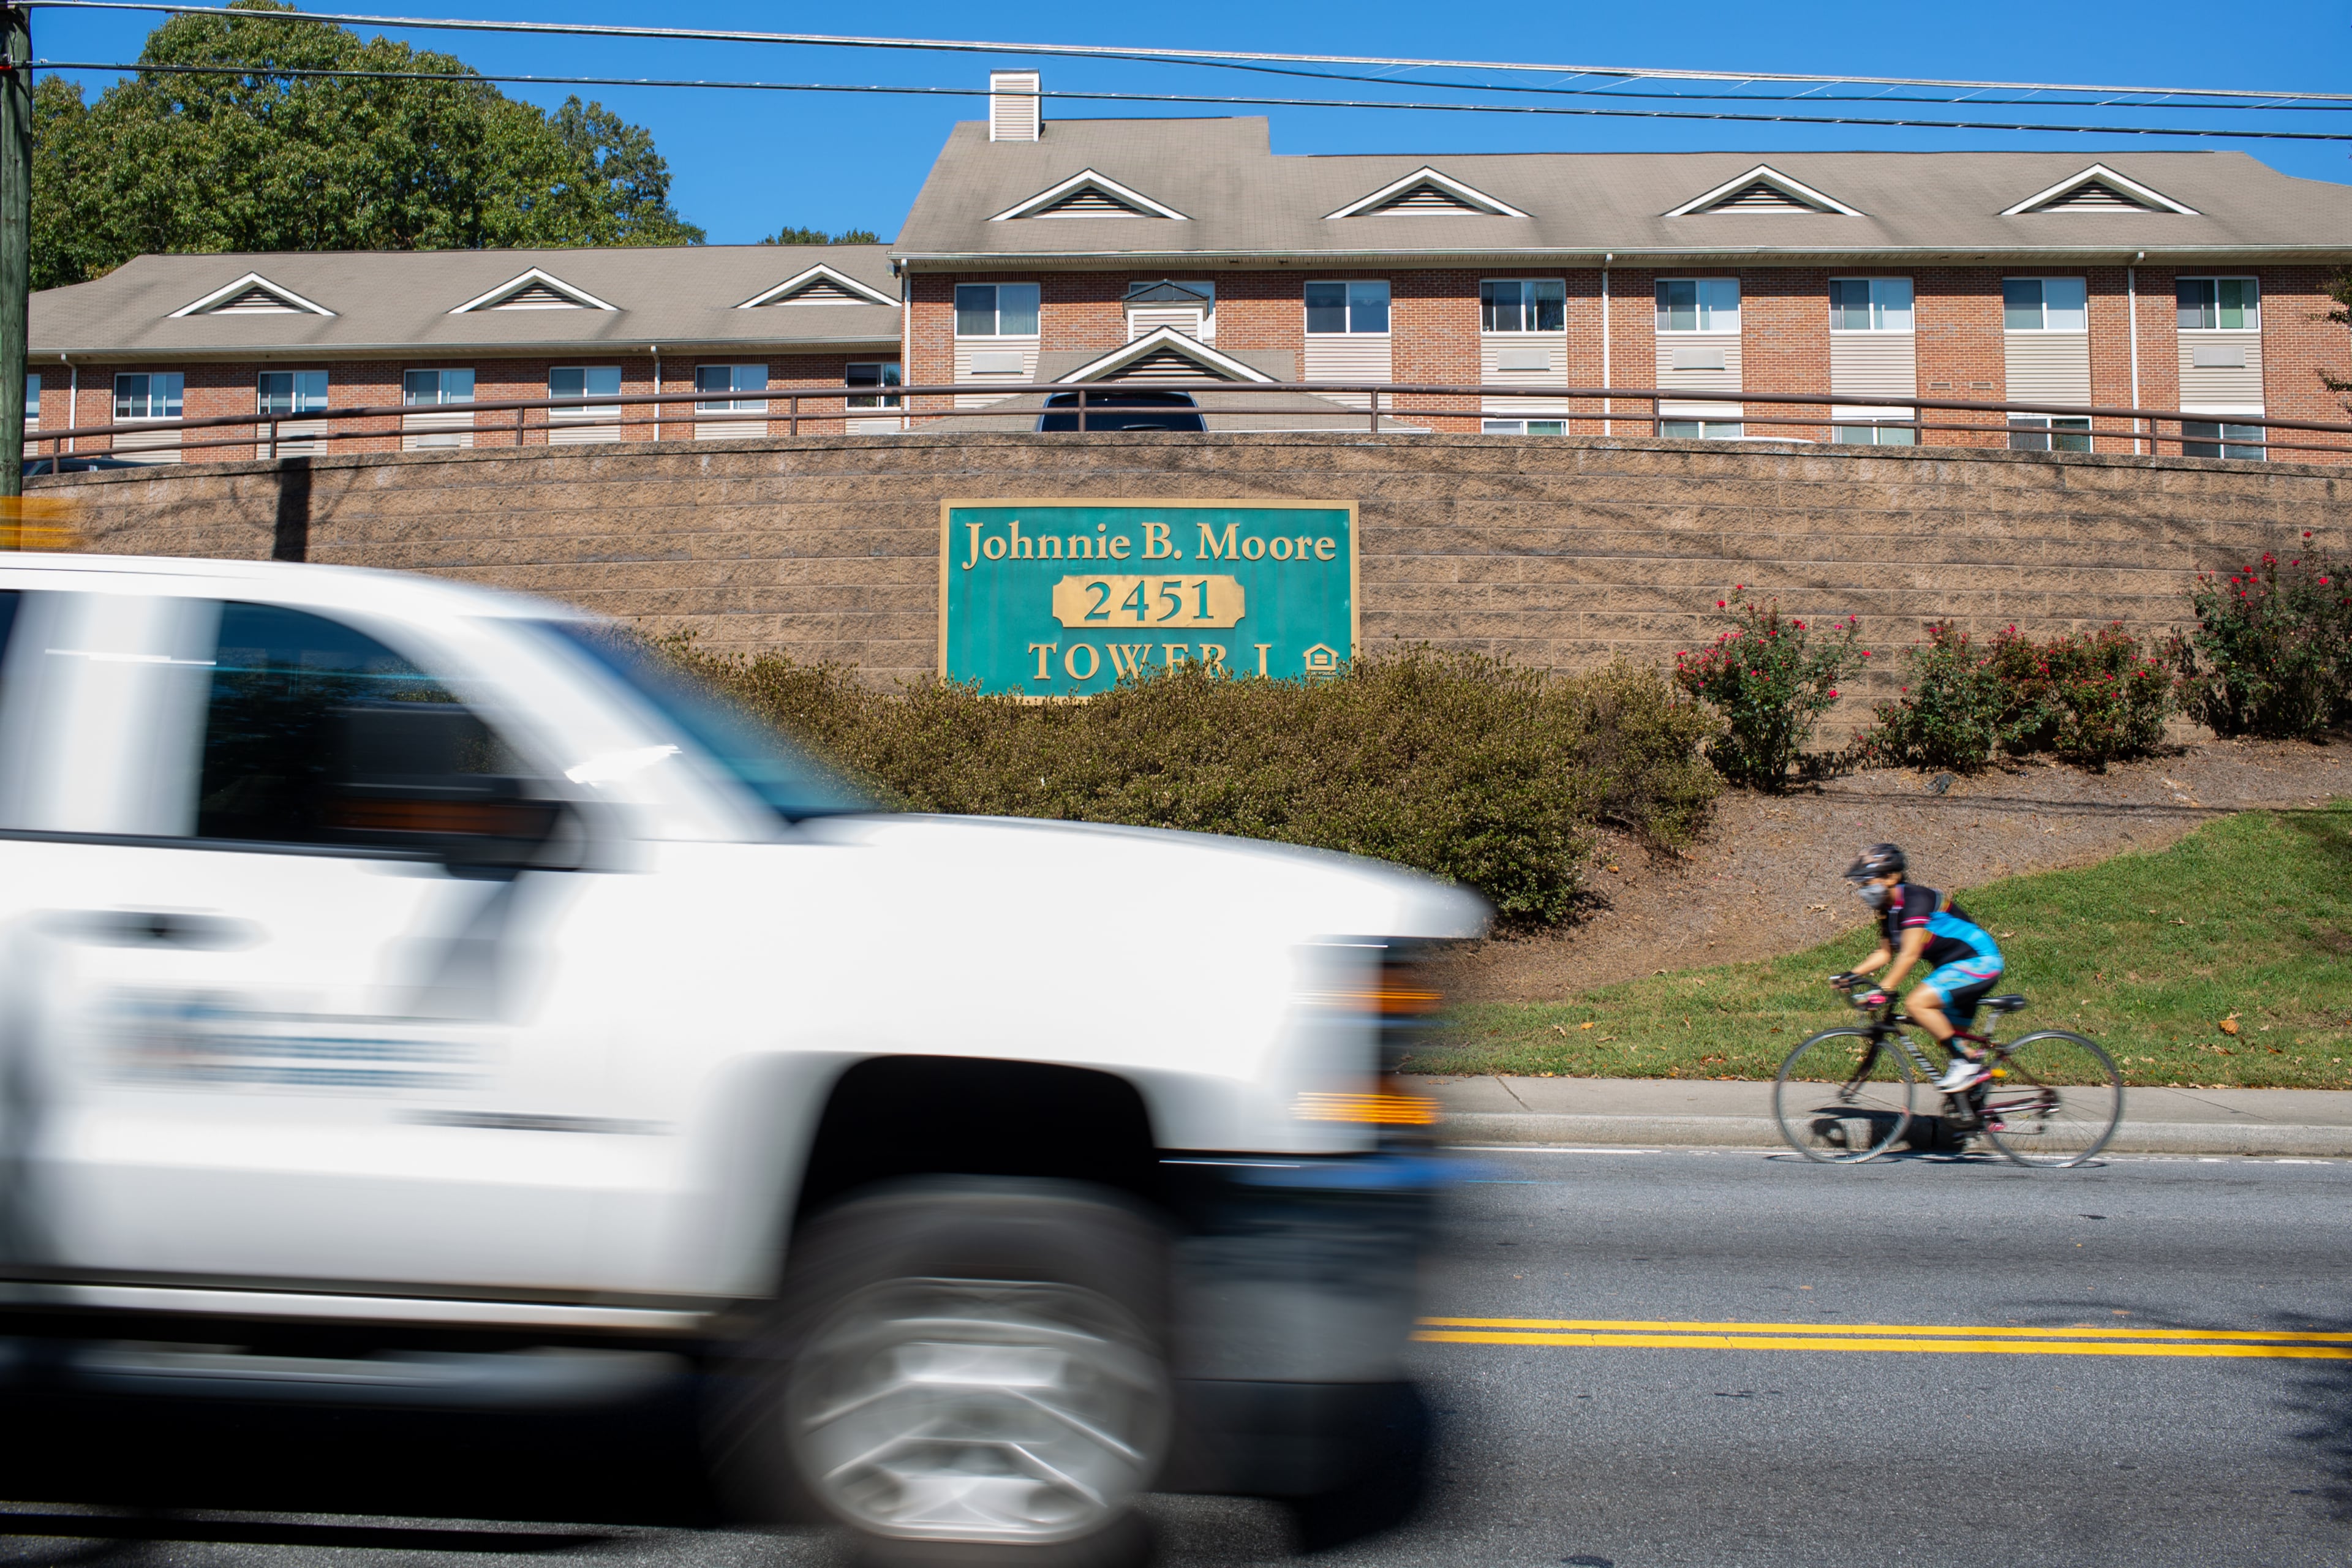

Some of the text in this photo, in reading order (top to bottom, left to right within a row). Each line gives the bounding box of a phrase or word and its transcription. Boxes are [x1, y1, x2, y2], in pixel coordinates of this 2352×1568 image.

[962, 520, 1336, 570] Johnnie B. Moore
[1084, 580, 1214, 622] 2451
[1028, 643, 1272, 680] TOWER I
